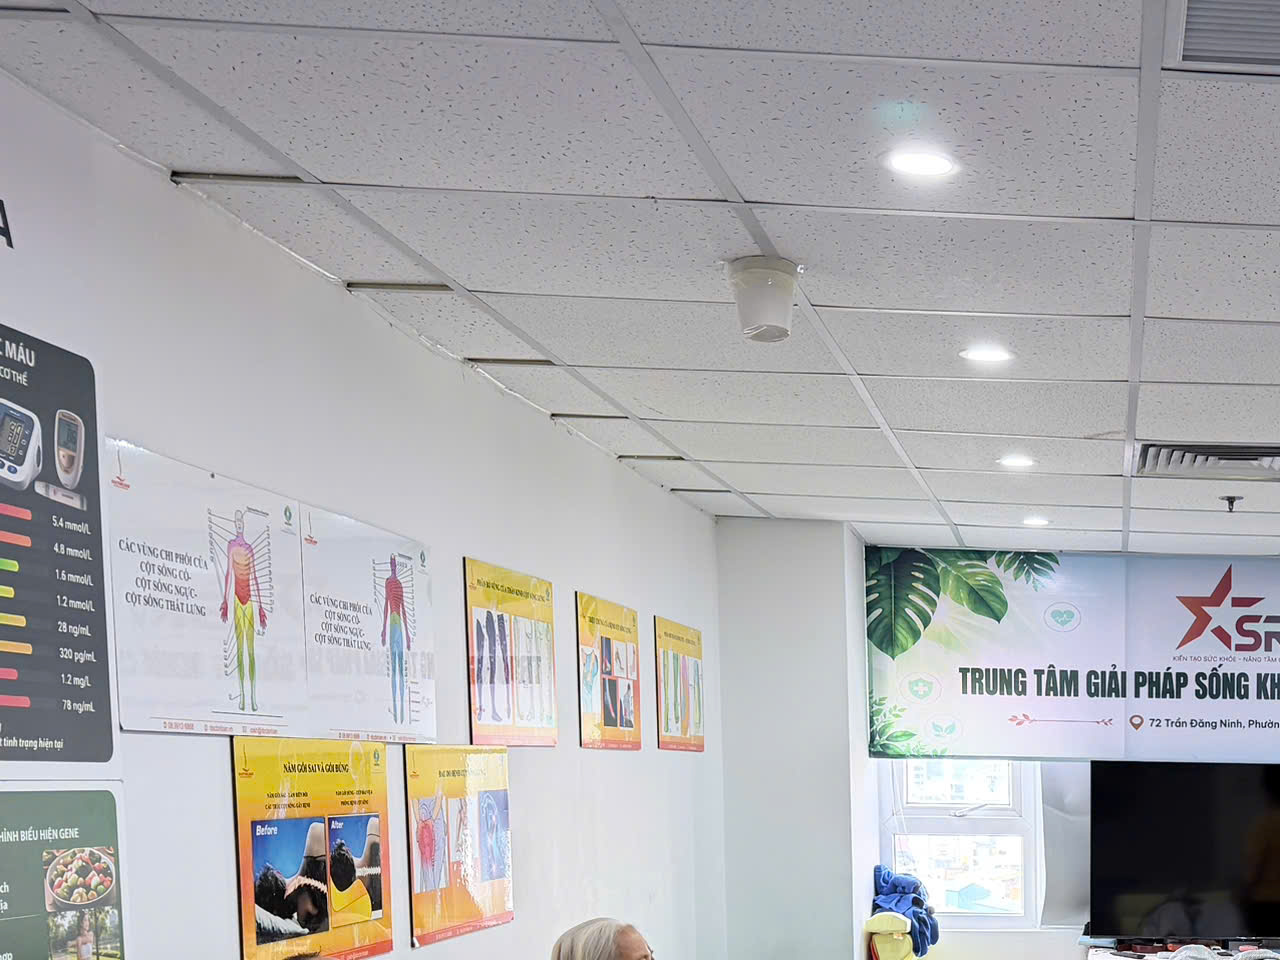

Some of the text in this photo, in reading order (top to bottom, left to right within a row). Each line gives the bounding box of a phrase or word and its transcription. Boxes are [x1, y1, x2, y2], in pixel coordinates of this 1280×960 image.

[5, 340, 35, 367] MÁU
[52, 515, 91, 535] 5.4 mmol/L
[53, 542, 93, 560] 4.8 mmol/L
[118, 537, 136, 553] CÁC
[137, 541, 159, 559] VÙNG
[55, 569, 94, 586] 1.6 mmol/L
[56, 595, 95, 612] 1.2 mmol/L
[57, 621, 91, 637] 28 ng/mL
[59, 647, 96, 663] 320 pg/mL
[61, 673, 91, 688] 1.2 mg/L
[958, 667, 1028, 697] TRUNG
[1033, 663, 1079, 698] TÂM
[1086, 662, 1127, 699] GIẢI
[1134, 666, 1189, 700] PHÁP
[1194, 663, 1250, 701] SỐNG
[62, 700, 96, 714] 78 ng/mL
[1149, 718, 1162, 728] 72
[1190, 718, 1218, 730] Đăng
[1219, 719, 1246, 729] Ninh,
[19, 738, 38, 750] trạng
[39, 737, 53, 751] hiện
[54, 738, 64, 751] tại
[255, 824, 278, 836] Before
[331, 820, 344, 830] After
[20, 826, 39, 841] BIỂU
[39, 826, 58, 843] HIỆN
[59, 828, 80, 839] GENE
